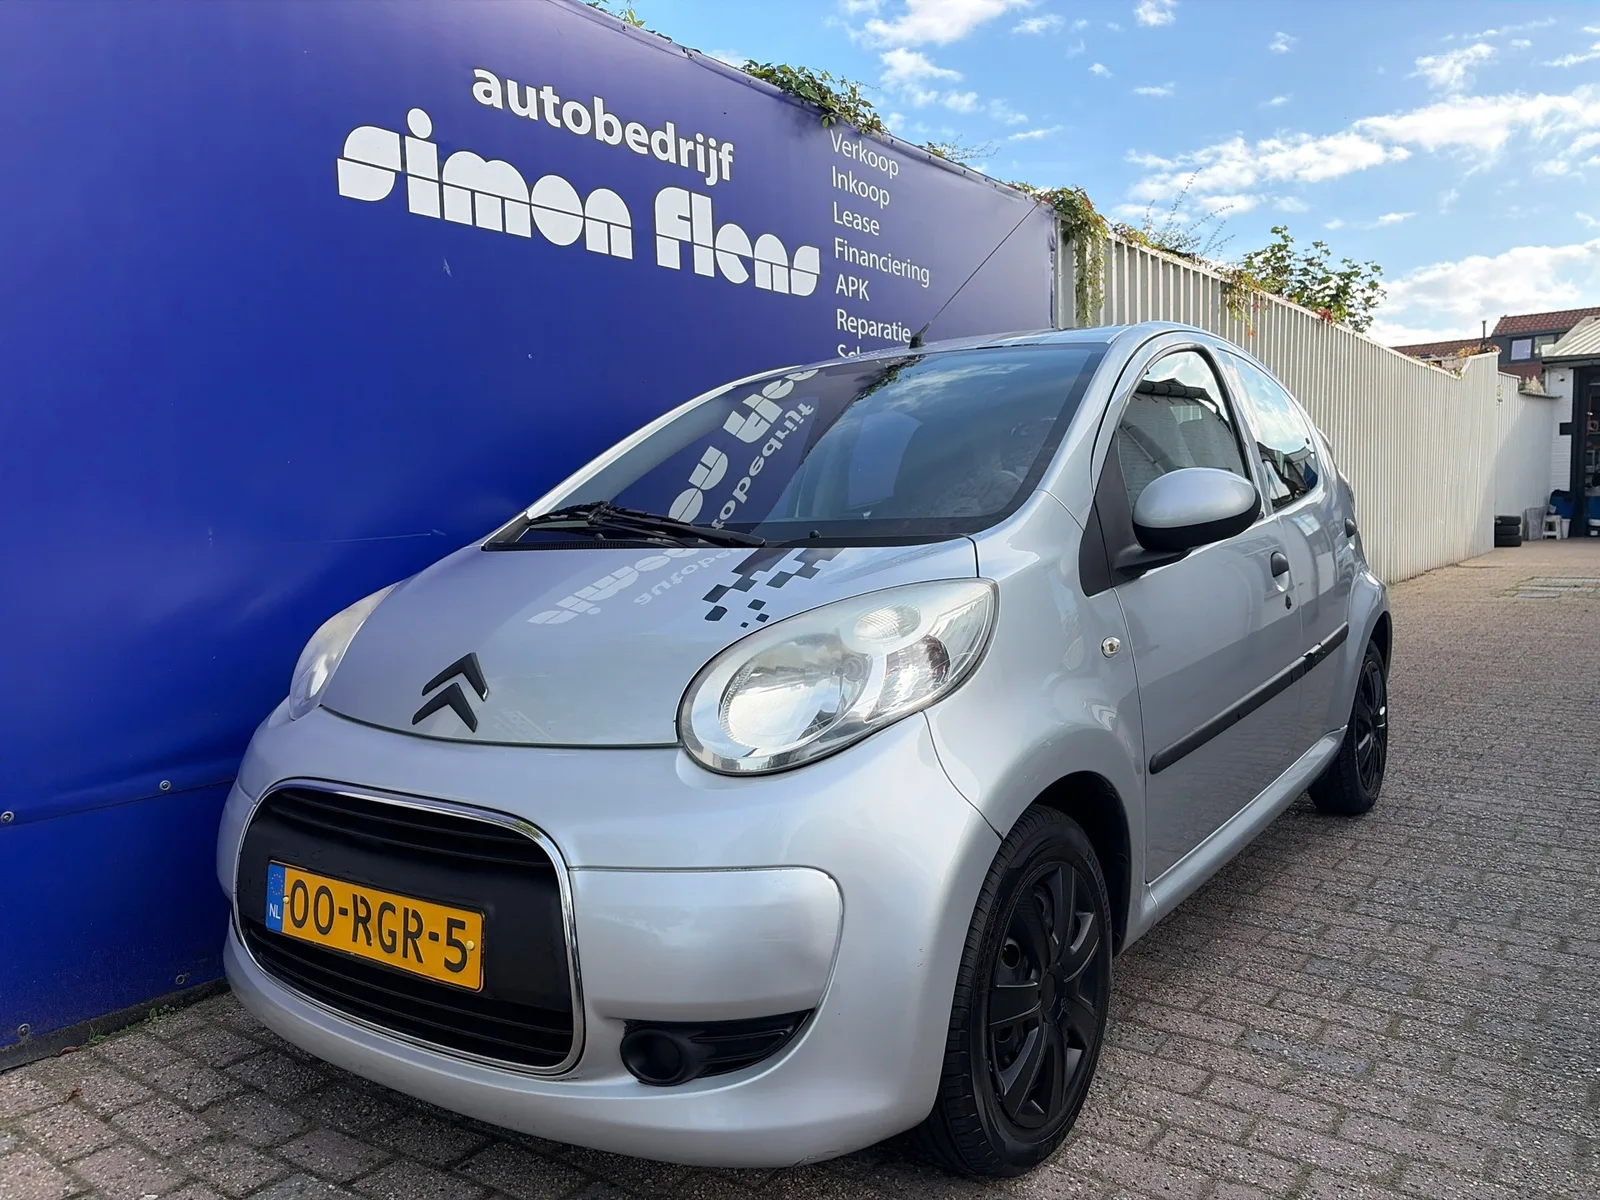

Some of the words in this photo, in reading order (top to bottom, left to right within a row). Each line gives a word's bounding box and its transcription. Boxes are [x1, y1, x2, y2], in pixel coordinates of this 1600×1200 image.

[472, 68, 735, 186] autobedrijf
[830, 129, 899, 179] Verkoop
[832, 165, 890, 209] Inkoop
[833, 201, 880, 236] Lease
[834, 237, 930, 288] Financiering
[835, 273, 870, 302] APK
[836, 308, 912, 343] Reparatie
[269, 903, 281, 920] NL
[289, 878, 468, 973] 00-RGR-5
